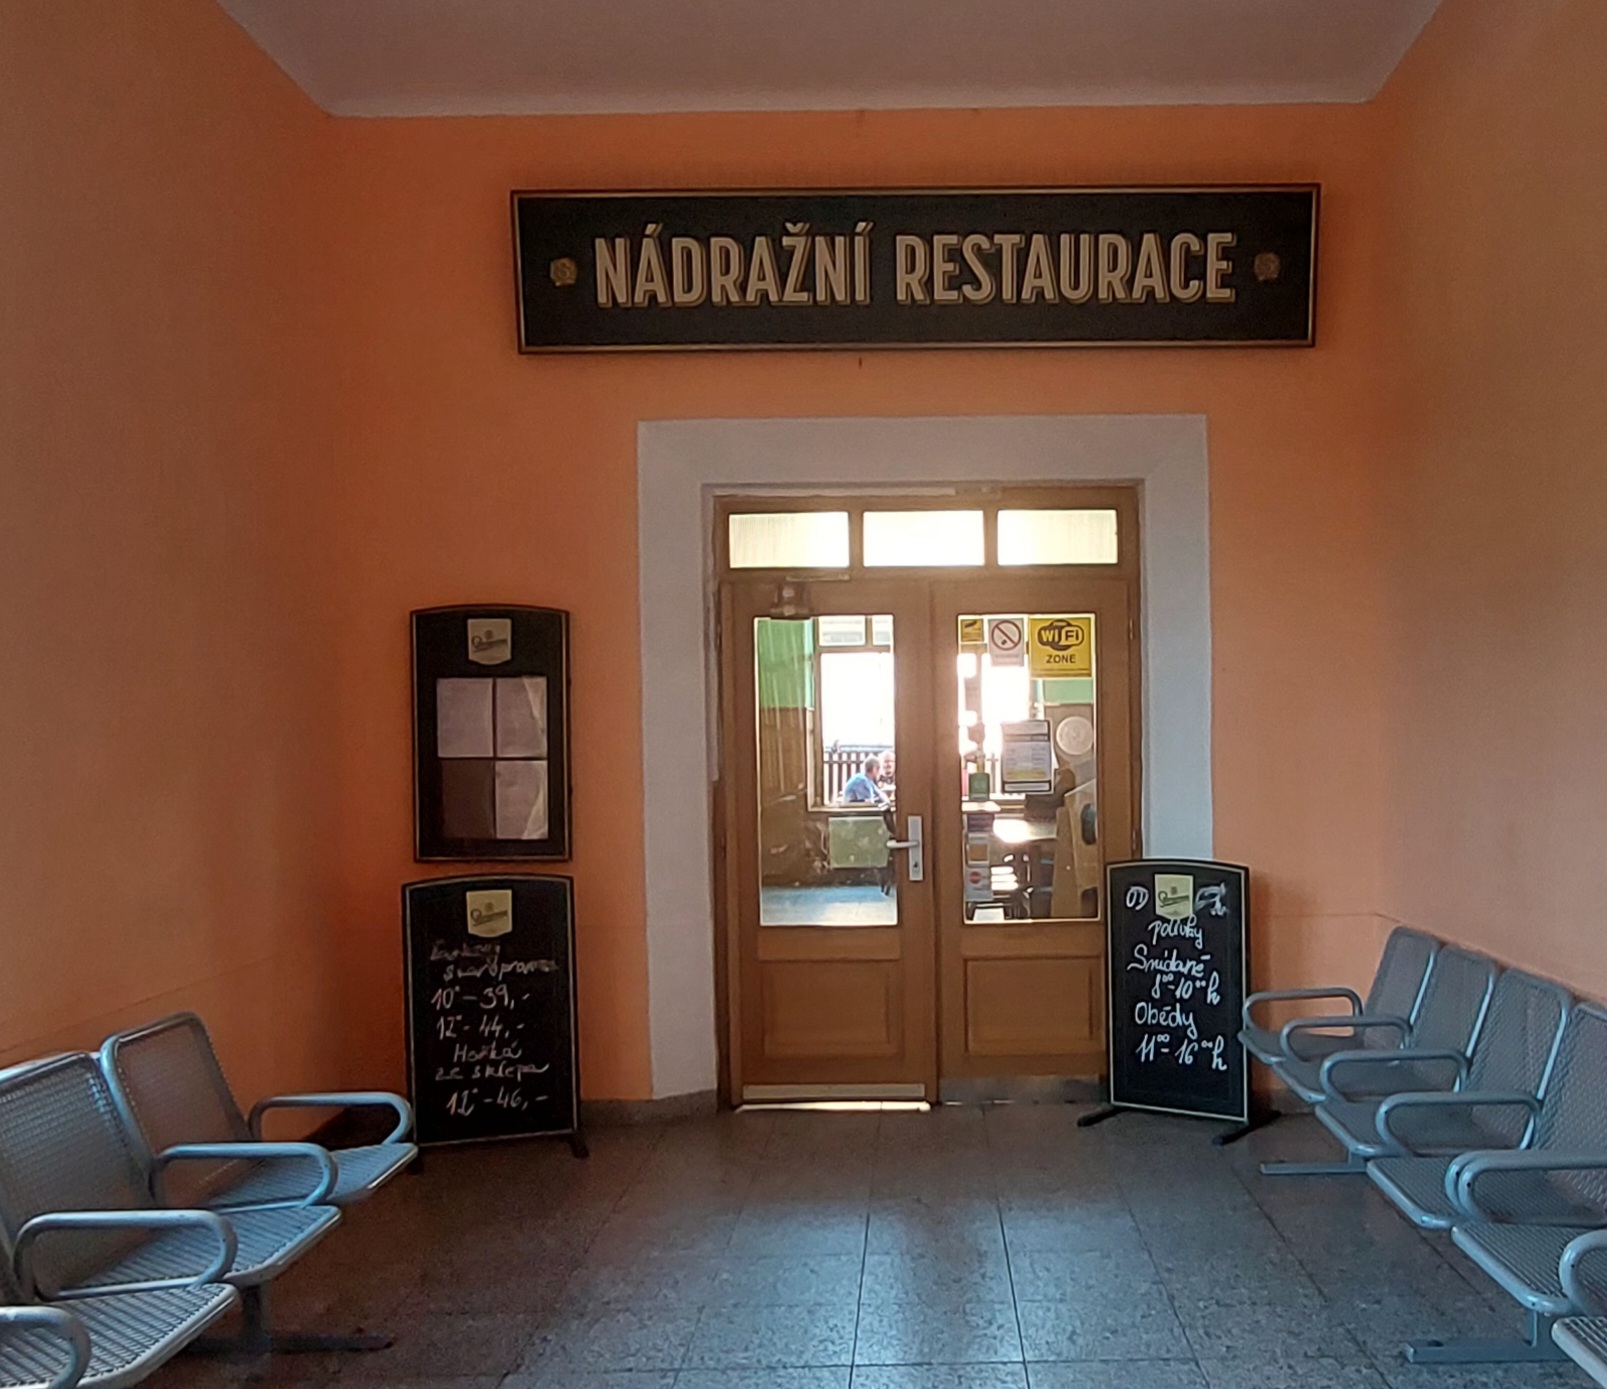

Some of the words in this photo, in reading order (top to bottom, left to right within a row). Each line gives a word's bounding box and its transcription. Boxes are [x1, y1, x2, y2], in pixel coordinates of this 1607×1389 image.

[594, 222, 874, 307] NÁDRAŽNÍ
[895, 231, 1237, 305] RESTAURACE
[1046, 654, 1077, 664] ZONE
